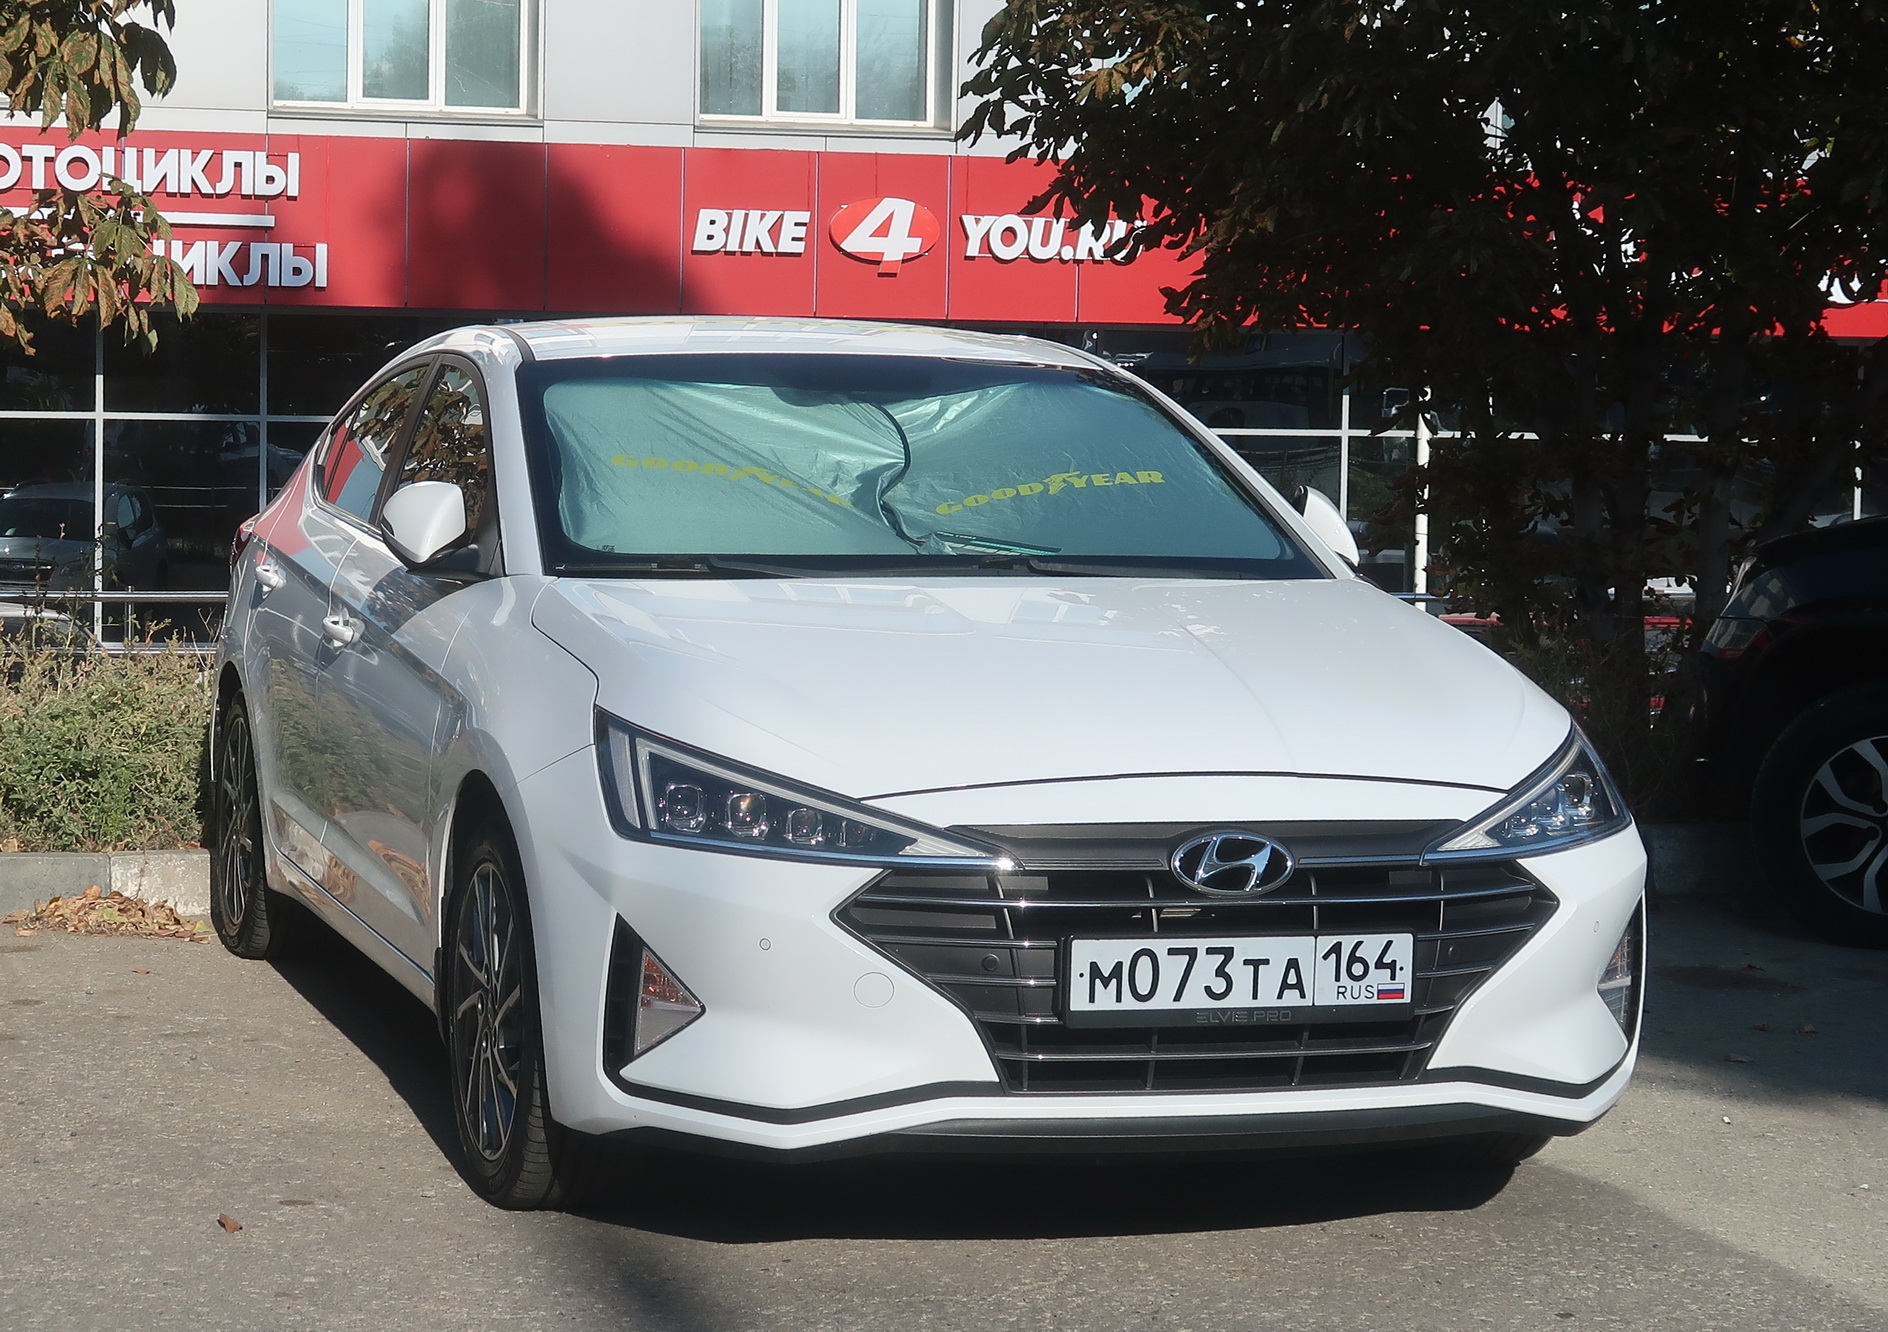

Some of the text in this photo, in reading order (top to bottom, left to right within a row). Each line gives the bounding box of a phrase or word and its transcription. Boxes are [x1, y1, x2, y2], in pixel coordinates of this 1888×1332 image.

[693, 208, 810, 255] BIKE
[840, 197, 922, 274] 4
[935, 470, 1165, 515] GOODYEAR
[1089, 940, 1398, 1004] М073ТА 164
[1336, 984, 1375, 1001] RUS
